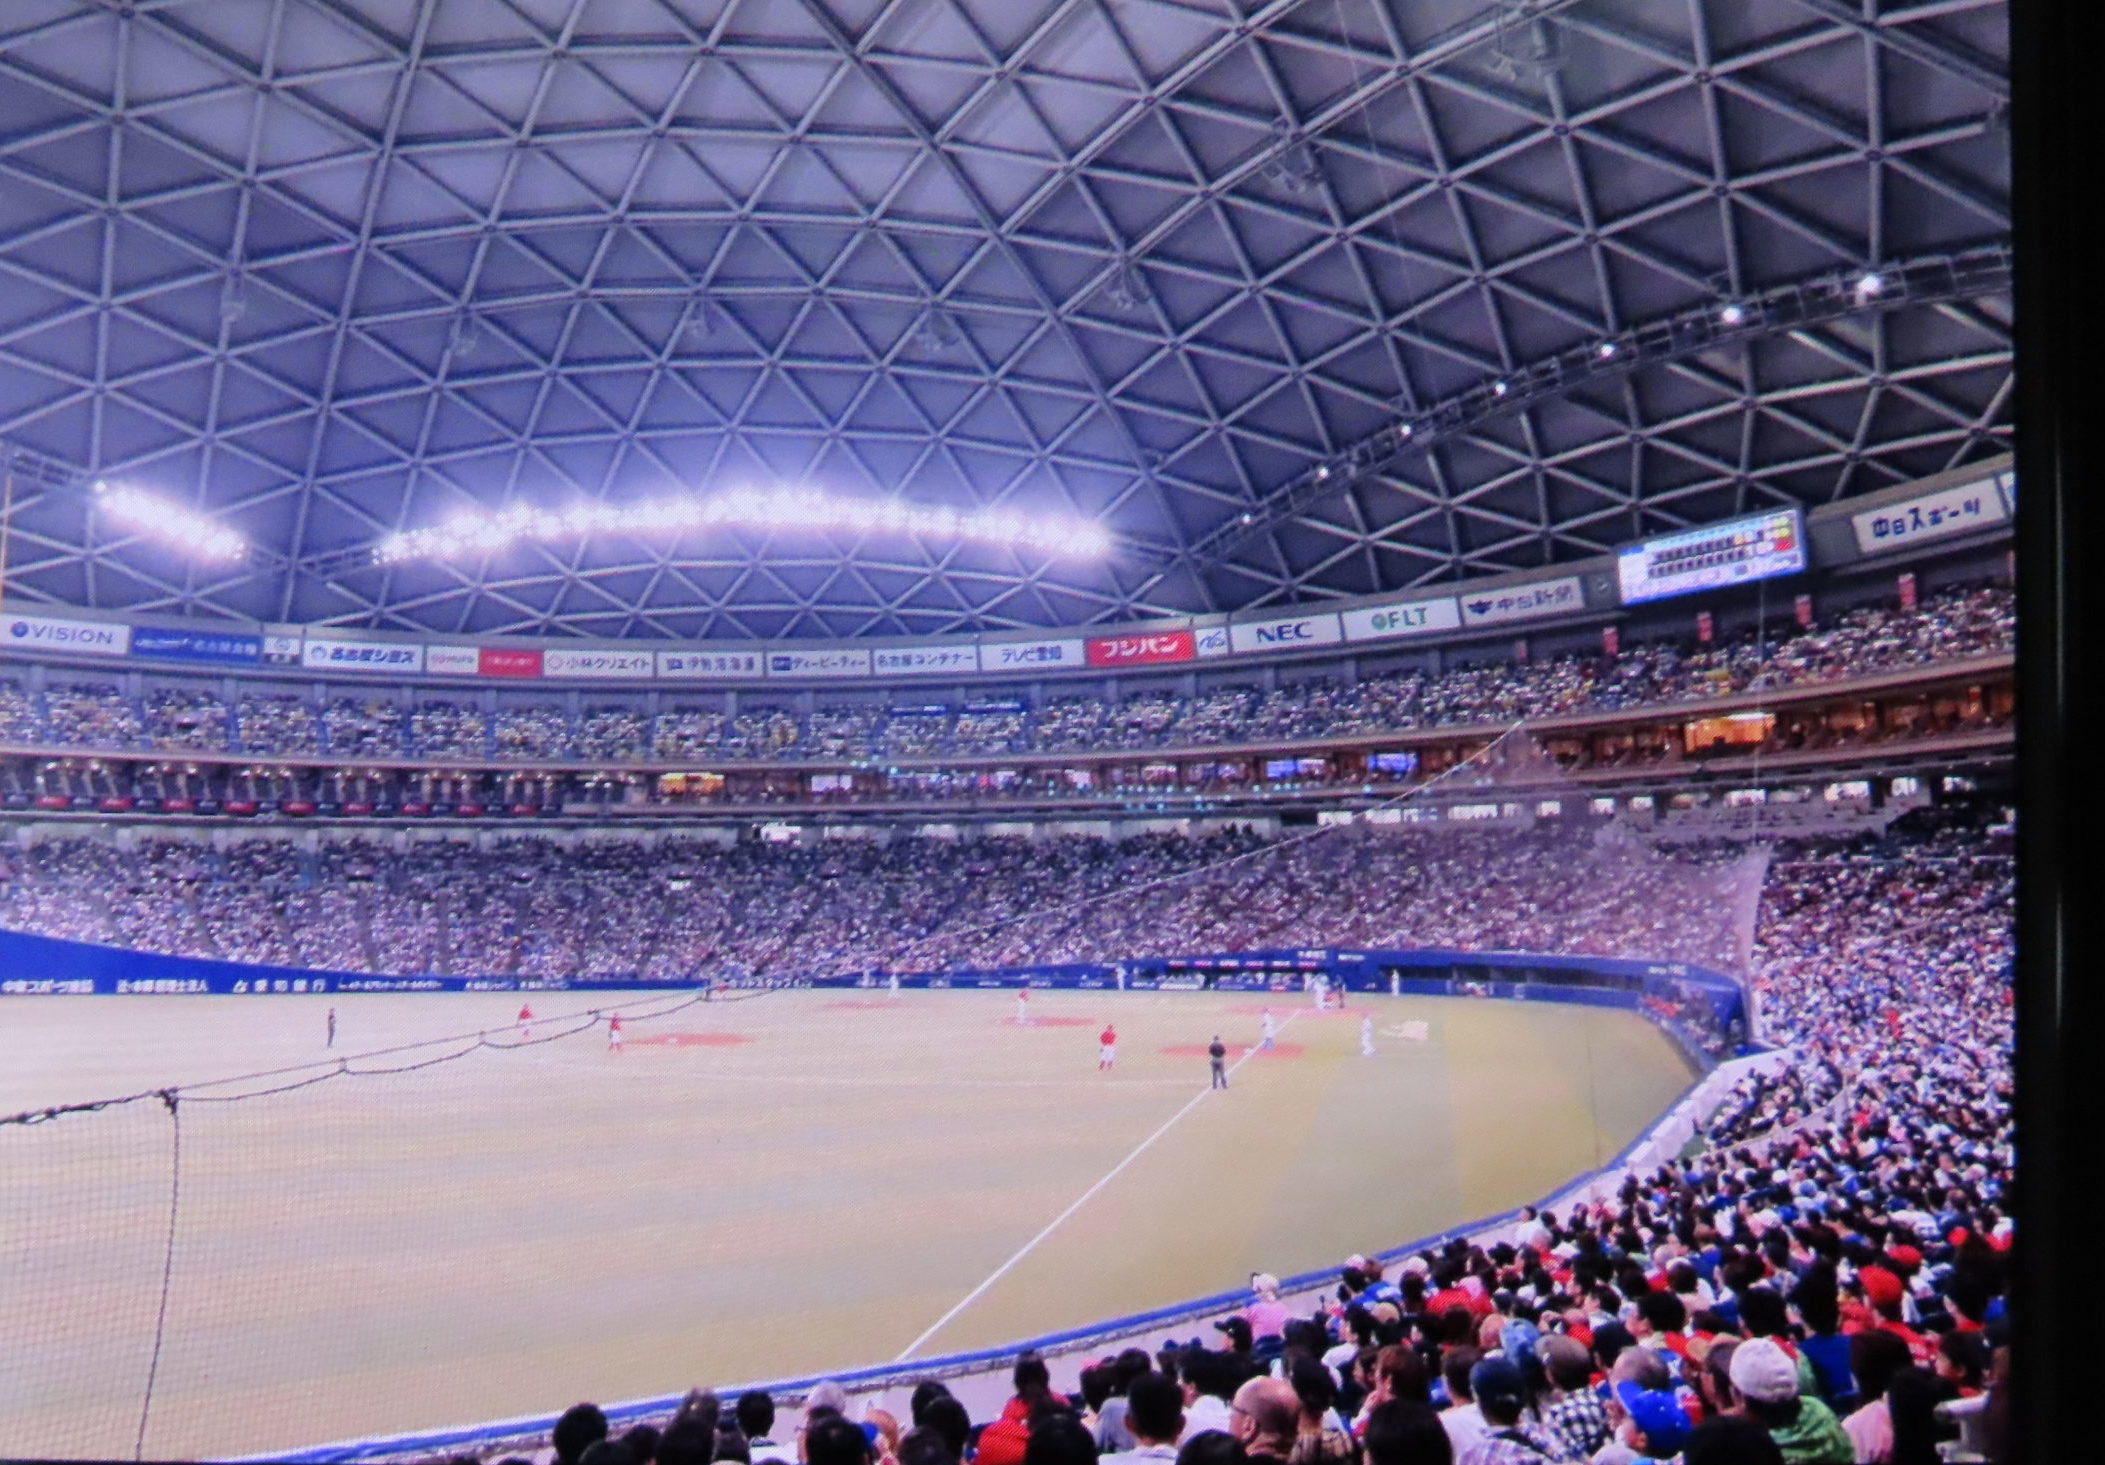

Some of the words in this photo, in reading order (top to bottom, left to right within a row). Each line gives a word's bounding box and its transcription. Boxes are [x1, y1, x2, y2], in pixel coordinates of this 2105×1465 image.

[1871, 497, 1981, 539] 中日スポーツ
[1497, 584, 1573, 611] 中日新聞
[1387, 607, 1428, 629] FLT
[31, 622, 113, 645] VISION
[1256, 621, 1314, 643] NEC
[1001, 645, 1062, 663] テレビ愛知
[1099, 636, 1179, 658] フジパン
[877, 652, 974, 668] 名古屋コンテナー
